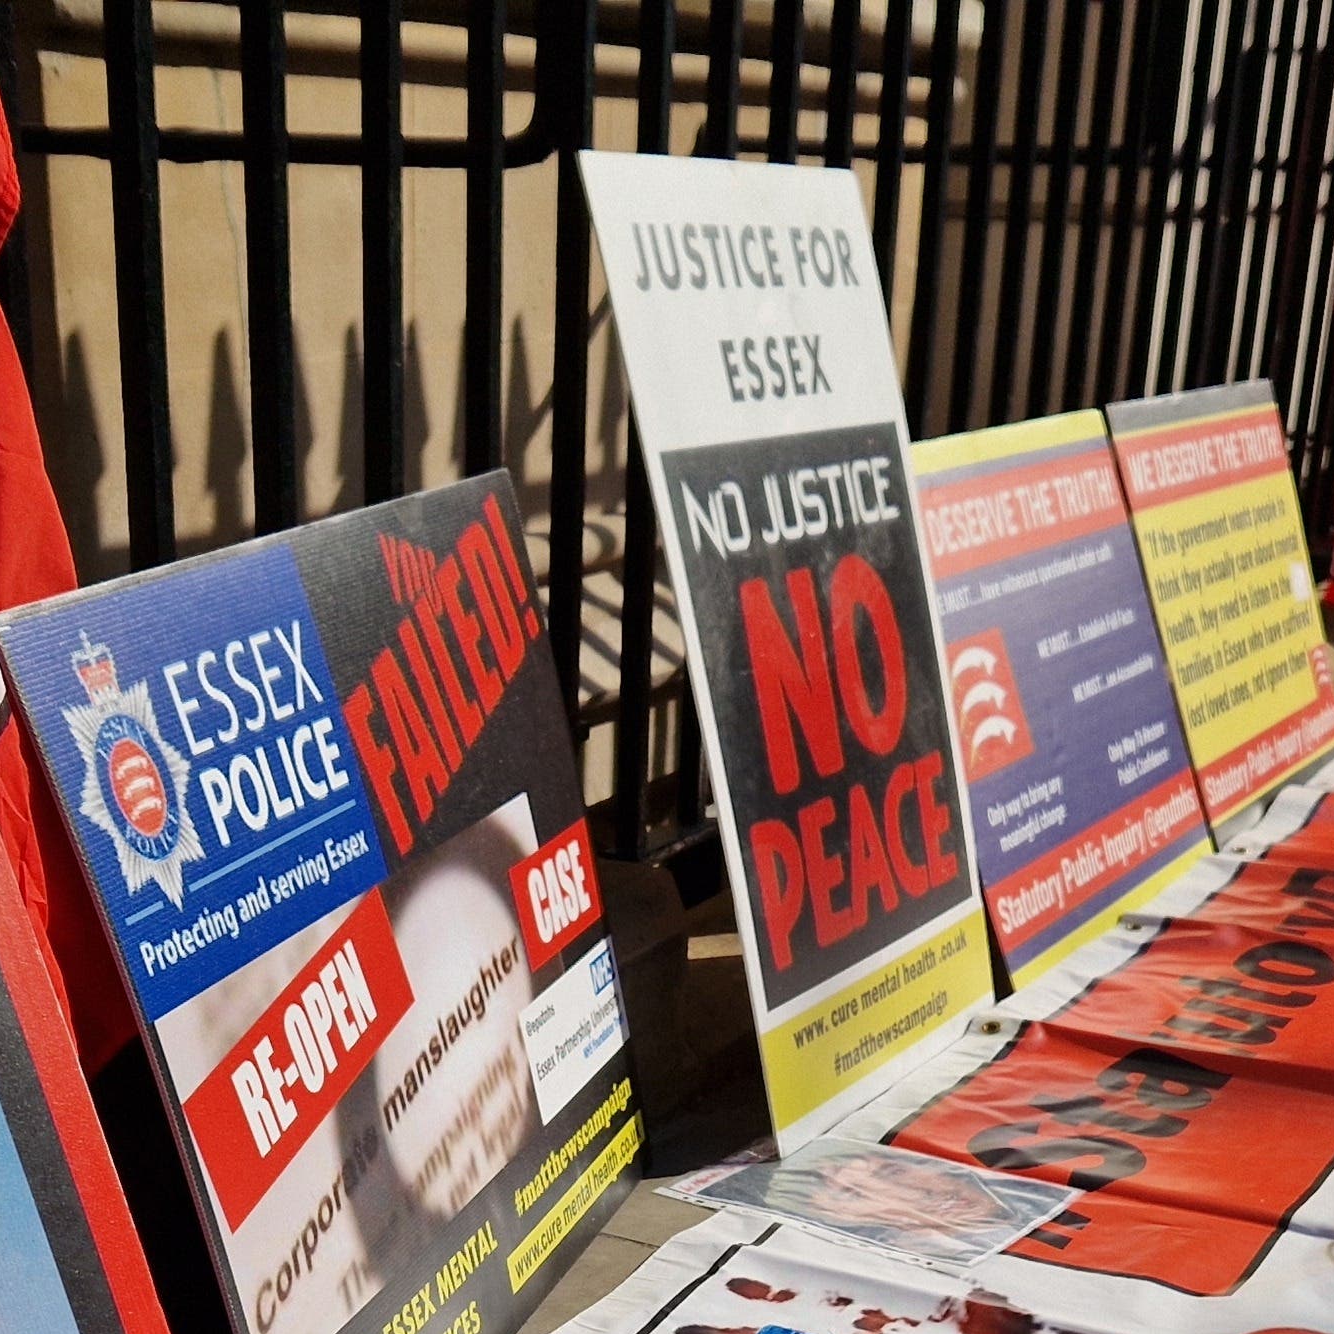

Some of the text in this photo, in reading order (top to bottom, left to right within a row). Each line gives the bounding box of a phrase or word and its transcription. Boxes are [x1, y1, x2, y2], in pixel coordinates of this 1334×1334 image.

[632, 222, 860, 292] JUSTICE FOR
[718, 335, 833, 403] ESSEX
[679, 456, 901, 561] NO JUSTICE
[923, 487, 1018, 557] DESERVE
[1016, 481, 1056, 531] THE
[163, 619, 323, 756] ESSEX
[342, 491, 541, 856] FAILED!
[740, 553, 909, 796] NO
[199, 717, 351, 848] POLICE
[139, 830, 370, 977] Protecting and serving Essex
[526, 838, 592, 945] CASE
[749, 749, 959, 972] PEACE
[997, 869, 1066, 934] Statutory
[1060, 838, 1106, 893] Public
[1101, 819, 1146, 867] Inquiry
[229, 938, 378, 1160] RE-OPEN
[381, 935, 522, 1133] manslaughter
[793, 1015, 830, 1049] www.
[830, 998, 859, 1028] cure
[860, 967, 901, 1011] mental
[902, 947, 937, 985] health
[833, 989, 949, 1077] #matthewscampaign
[535, 1051, 557, 1082] Essex
[514, 1077, 633, 1217] #matthewscampaign
[562, 1180, 594, 1227] mental
[592, 1148, 619, 1189] health
[434, 1219, 499, 1306] MENTAL
